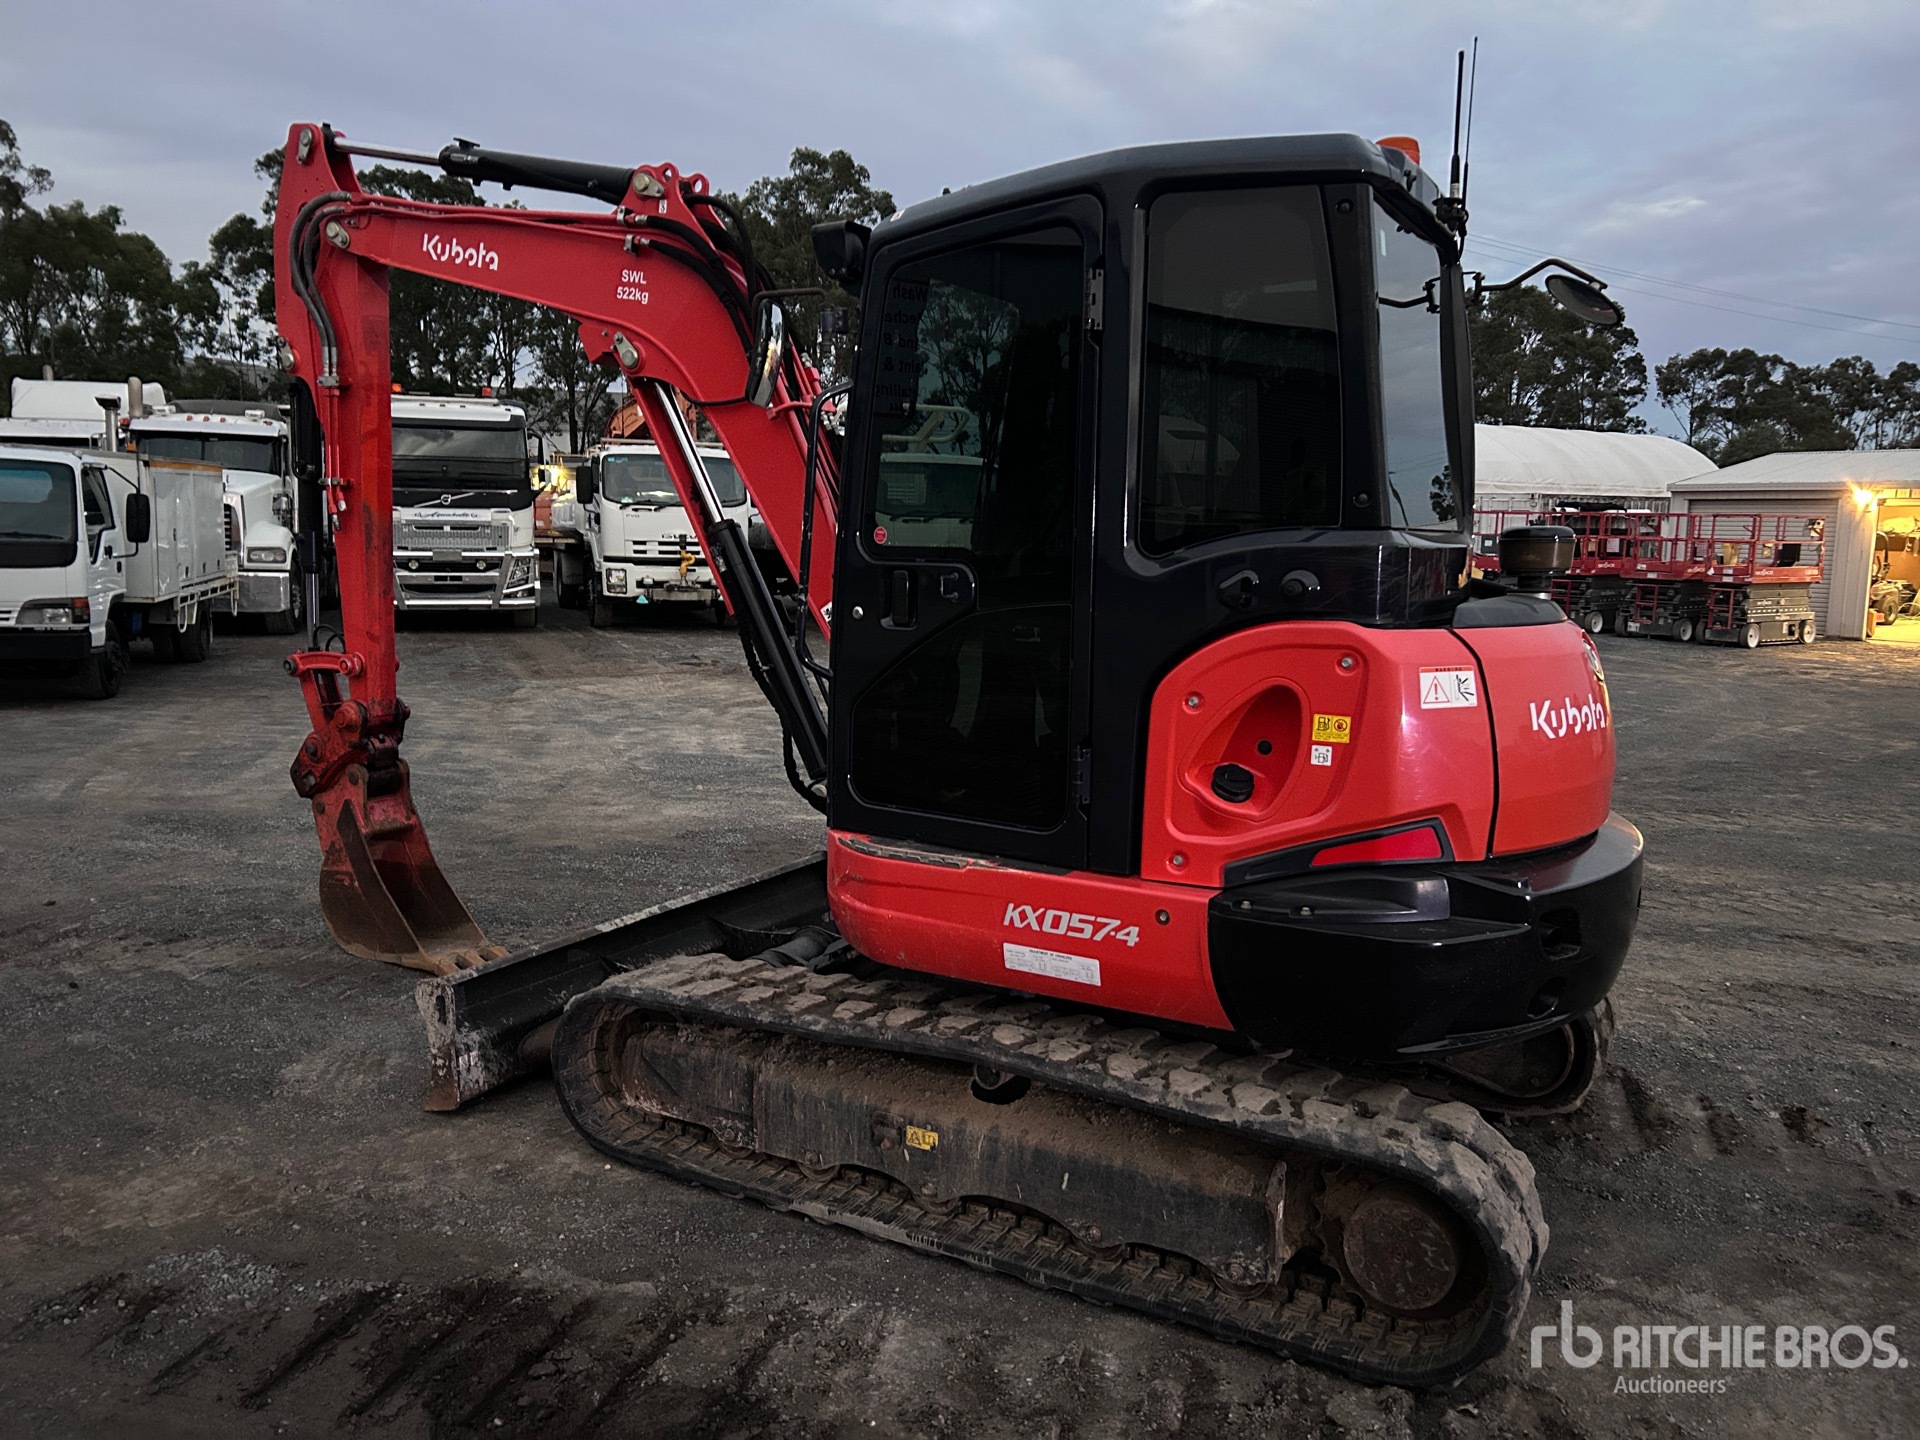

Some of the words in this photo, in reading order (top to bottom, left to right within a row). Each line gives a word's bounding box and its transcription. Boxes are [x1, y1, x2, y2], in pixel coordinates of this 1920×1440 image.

[422, 233, 499, 271] Kubota
[620, 268, 648, 285] SWL
[615, 285, 649, 305] 522kg
[1529, 693, 1606, 739] Kubota
